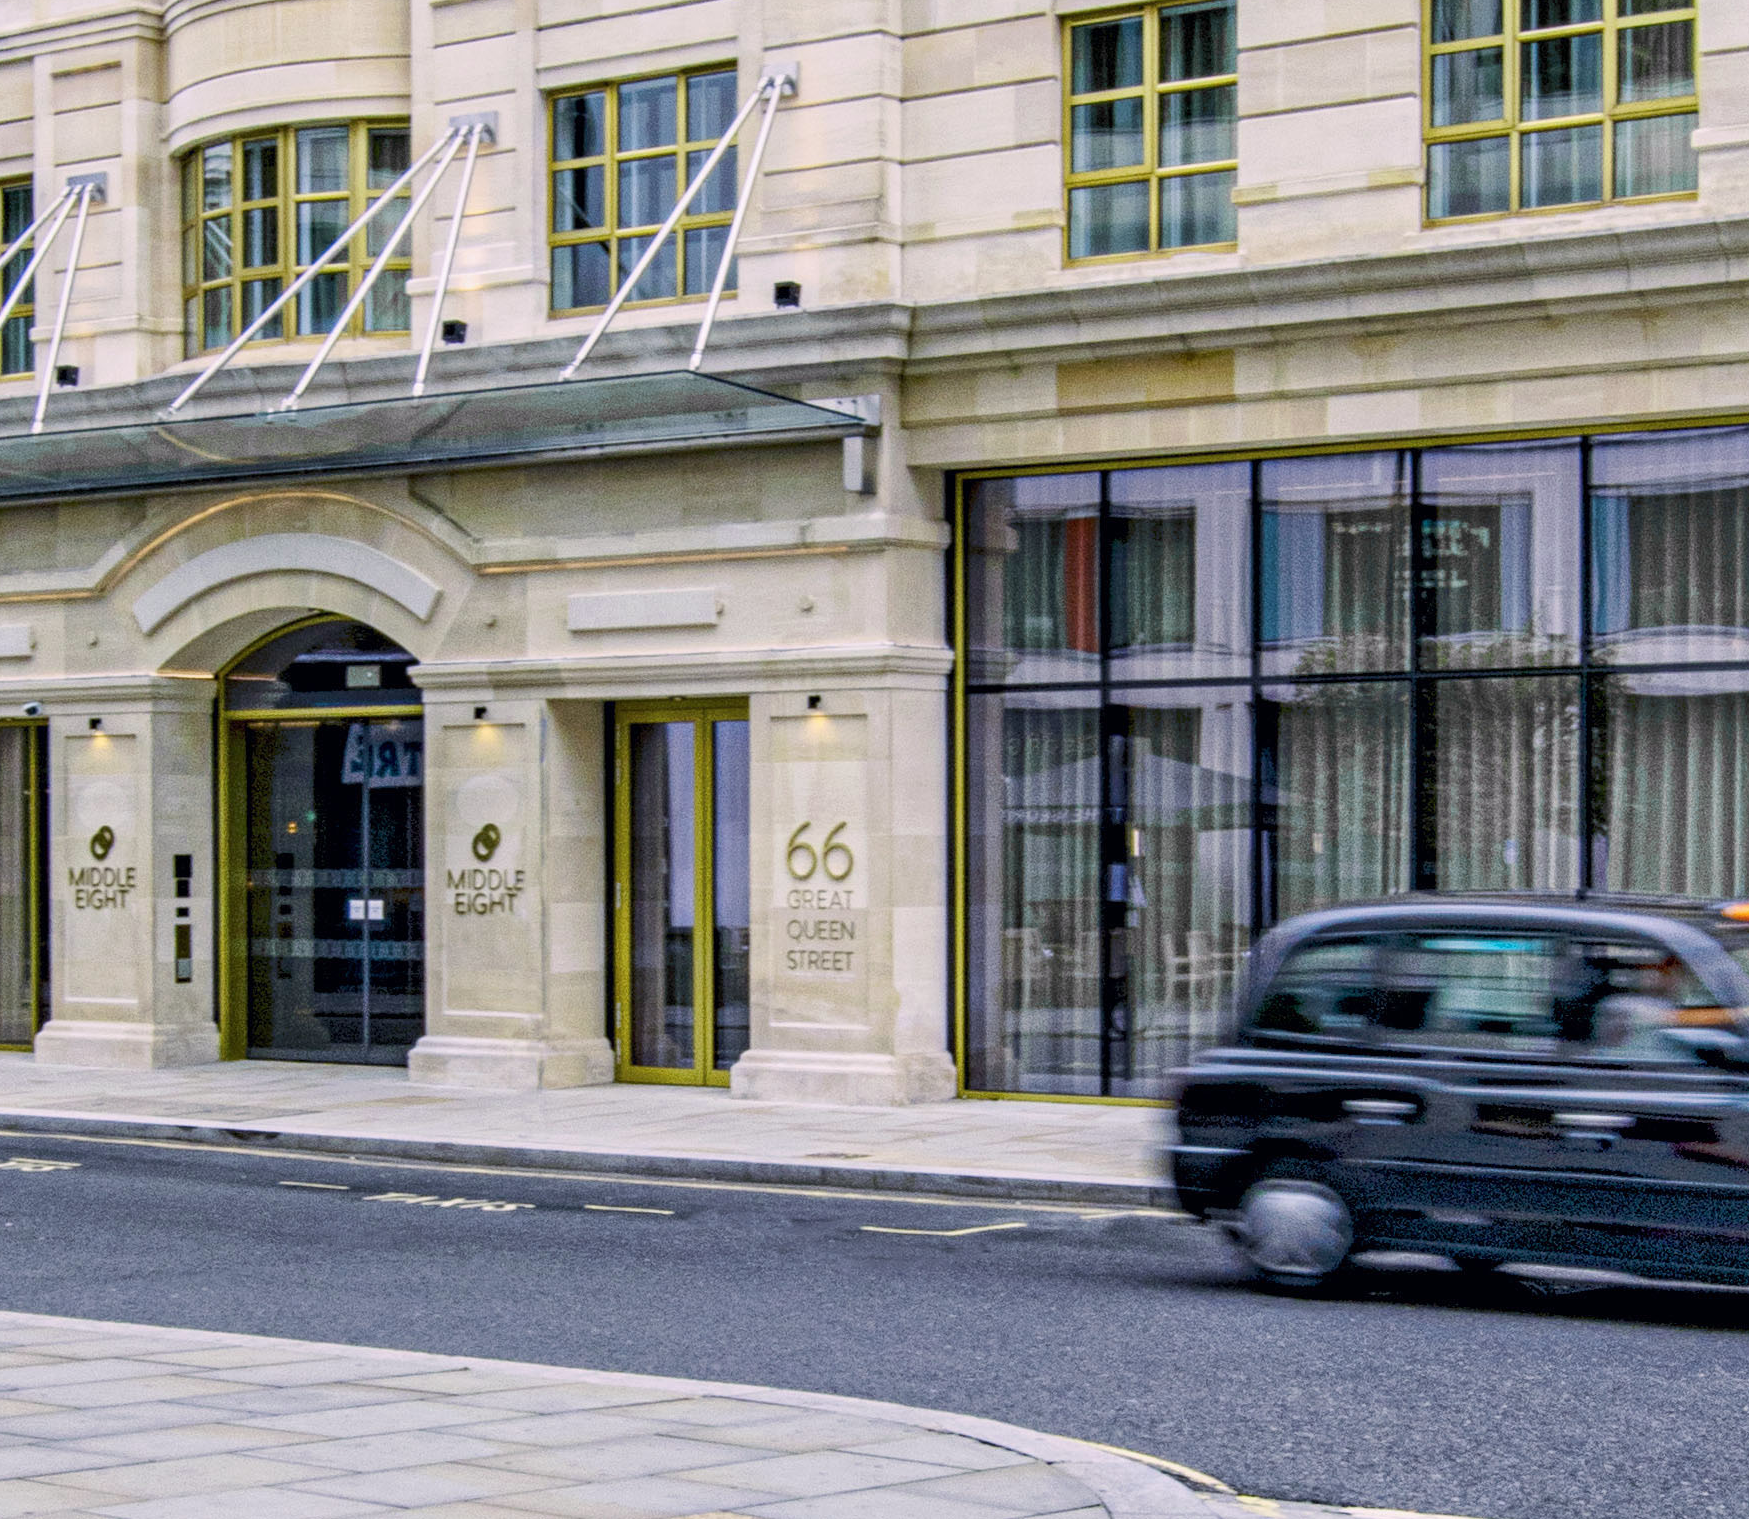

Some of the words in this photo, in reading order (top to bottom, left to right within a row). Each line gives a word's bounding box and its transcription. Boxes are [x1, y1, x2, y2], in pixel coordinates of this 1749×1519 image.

[786, 821, 854, 881] 66
[68, 867, 136, 887] MIDDLE
[447, 869, 525, 891] MIDDLE
[74, 889, 129, 910] EIGHT
[455, 892, 517, 915] EIGHT
[787, 889, 854, 910] GREAT
[786, 919, 856, 942] QUEEN
[786, 949, 854, 971] STREET
